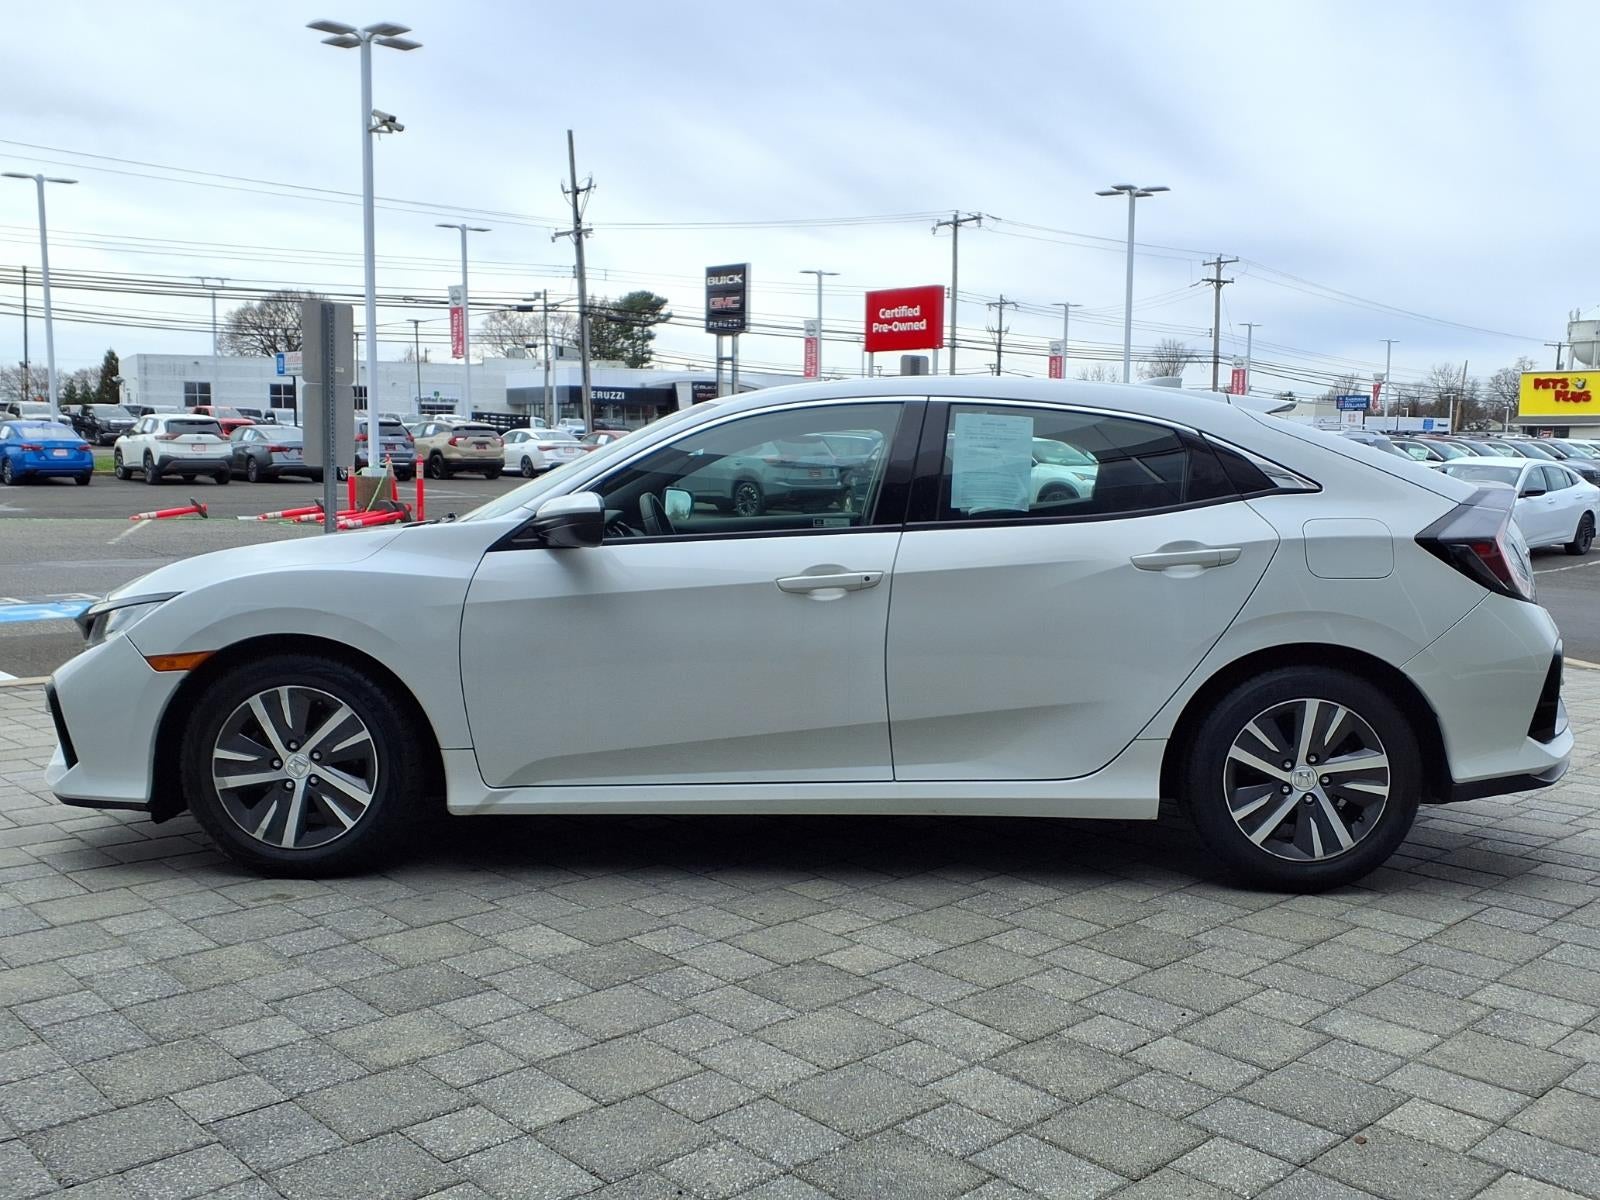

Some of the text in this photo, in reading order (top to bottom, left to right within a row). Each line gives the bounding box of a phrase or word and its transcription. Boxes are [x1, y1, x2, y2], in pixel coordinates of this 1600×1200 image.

[707, 274, 743, 286] BUICK
[709, 296, 741, 309] GMC
[879, 305, 921, 319] Certified
[872, 319, 928, 333] Pre-Owned
[1533, 378, 1570, 390] PETS
[591, 391, 625, 400] ERUZZI
[1554, 390, 1592, 403] PLUS
